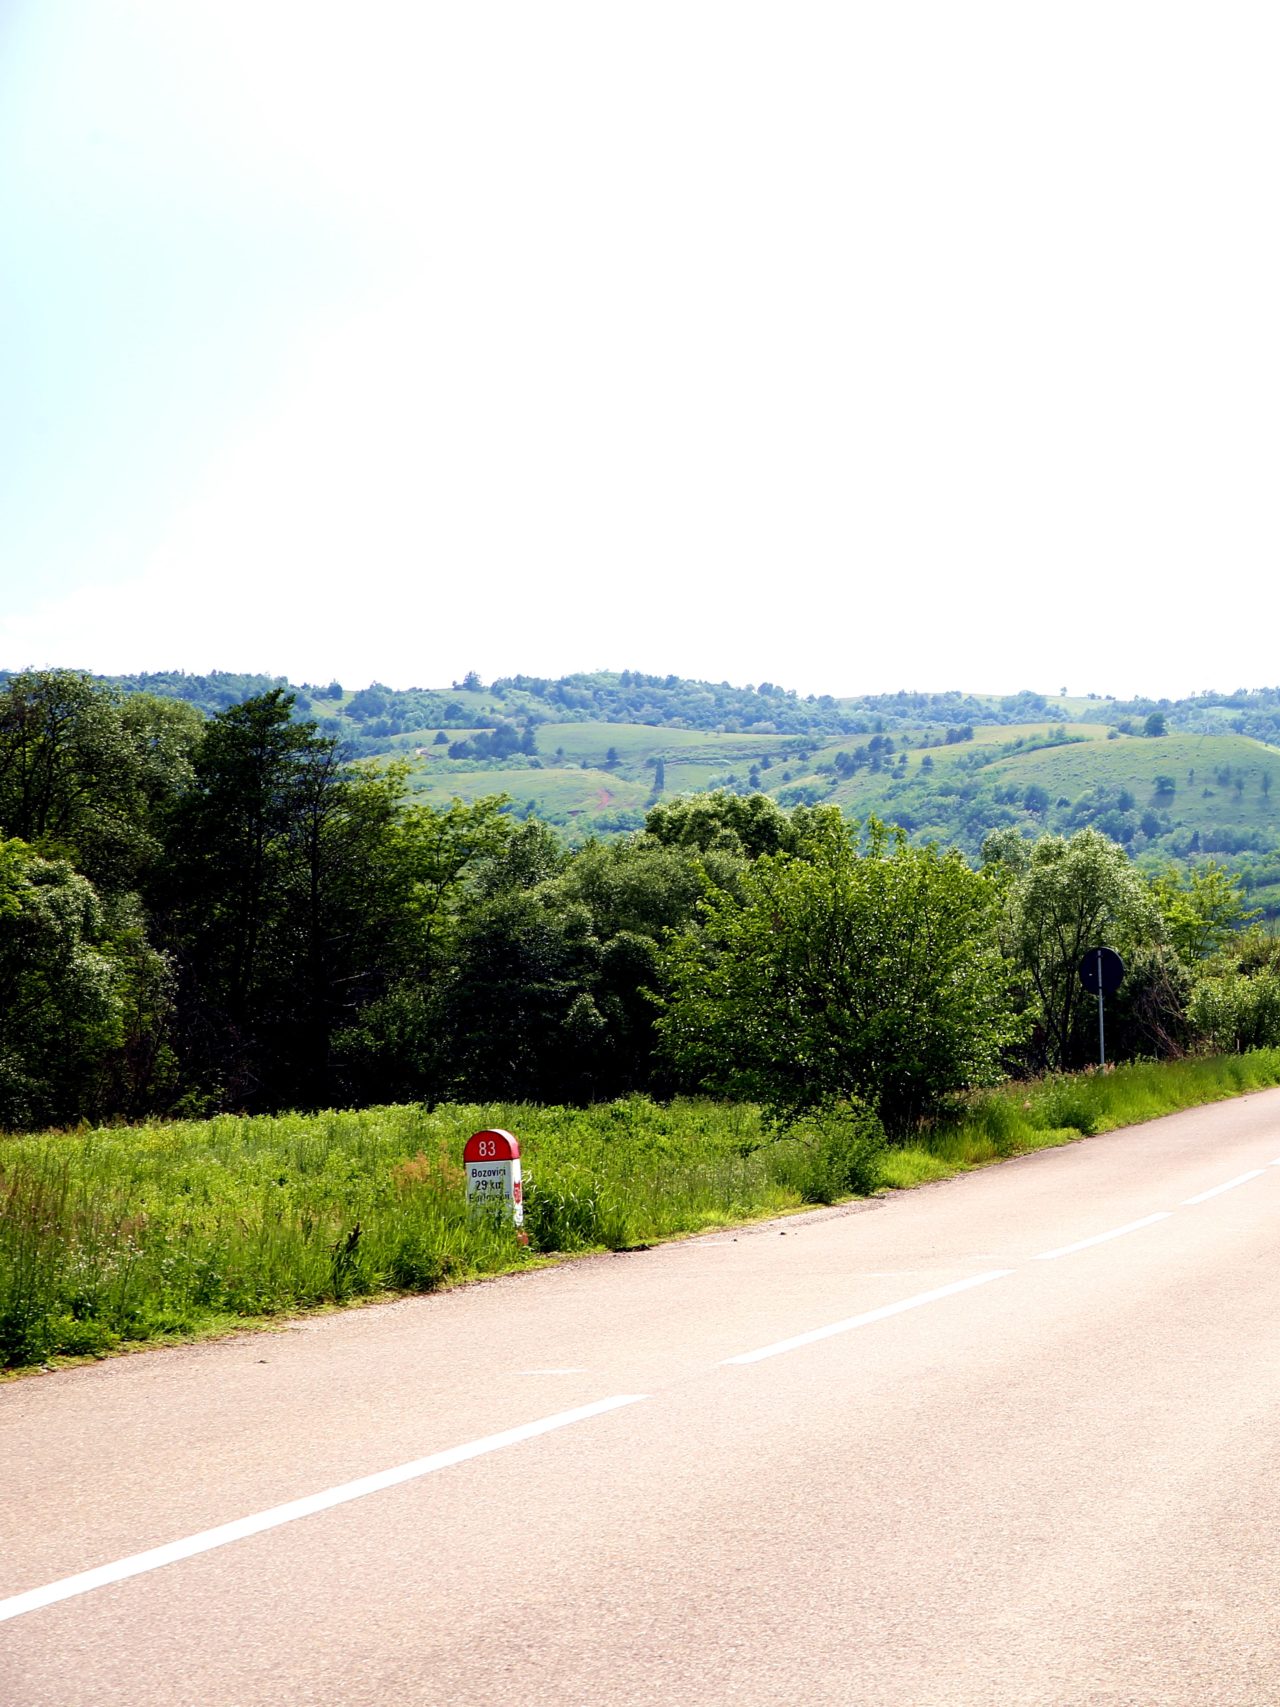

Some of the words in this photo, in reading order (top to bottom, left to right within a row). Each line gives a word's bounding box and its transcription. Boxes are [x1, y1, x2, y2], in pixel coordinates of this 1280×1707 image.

[479, 1141, 495, 1156] 83
[471, 1167, 506, 1178] Bozovici
[475, 1180, 488, 1190] 29
